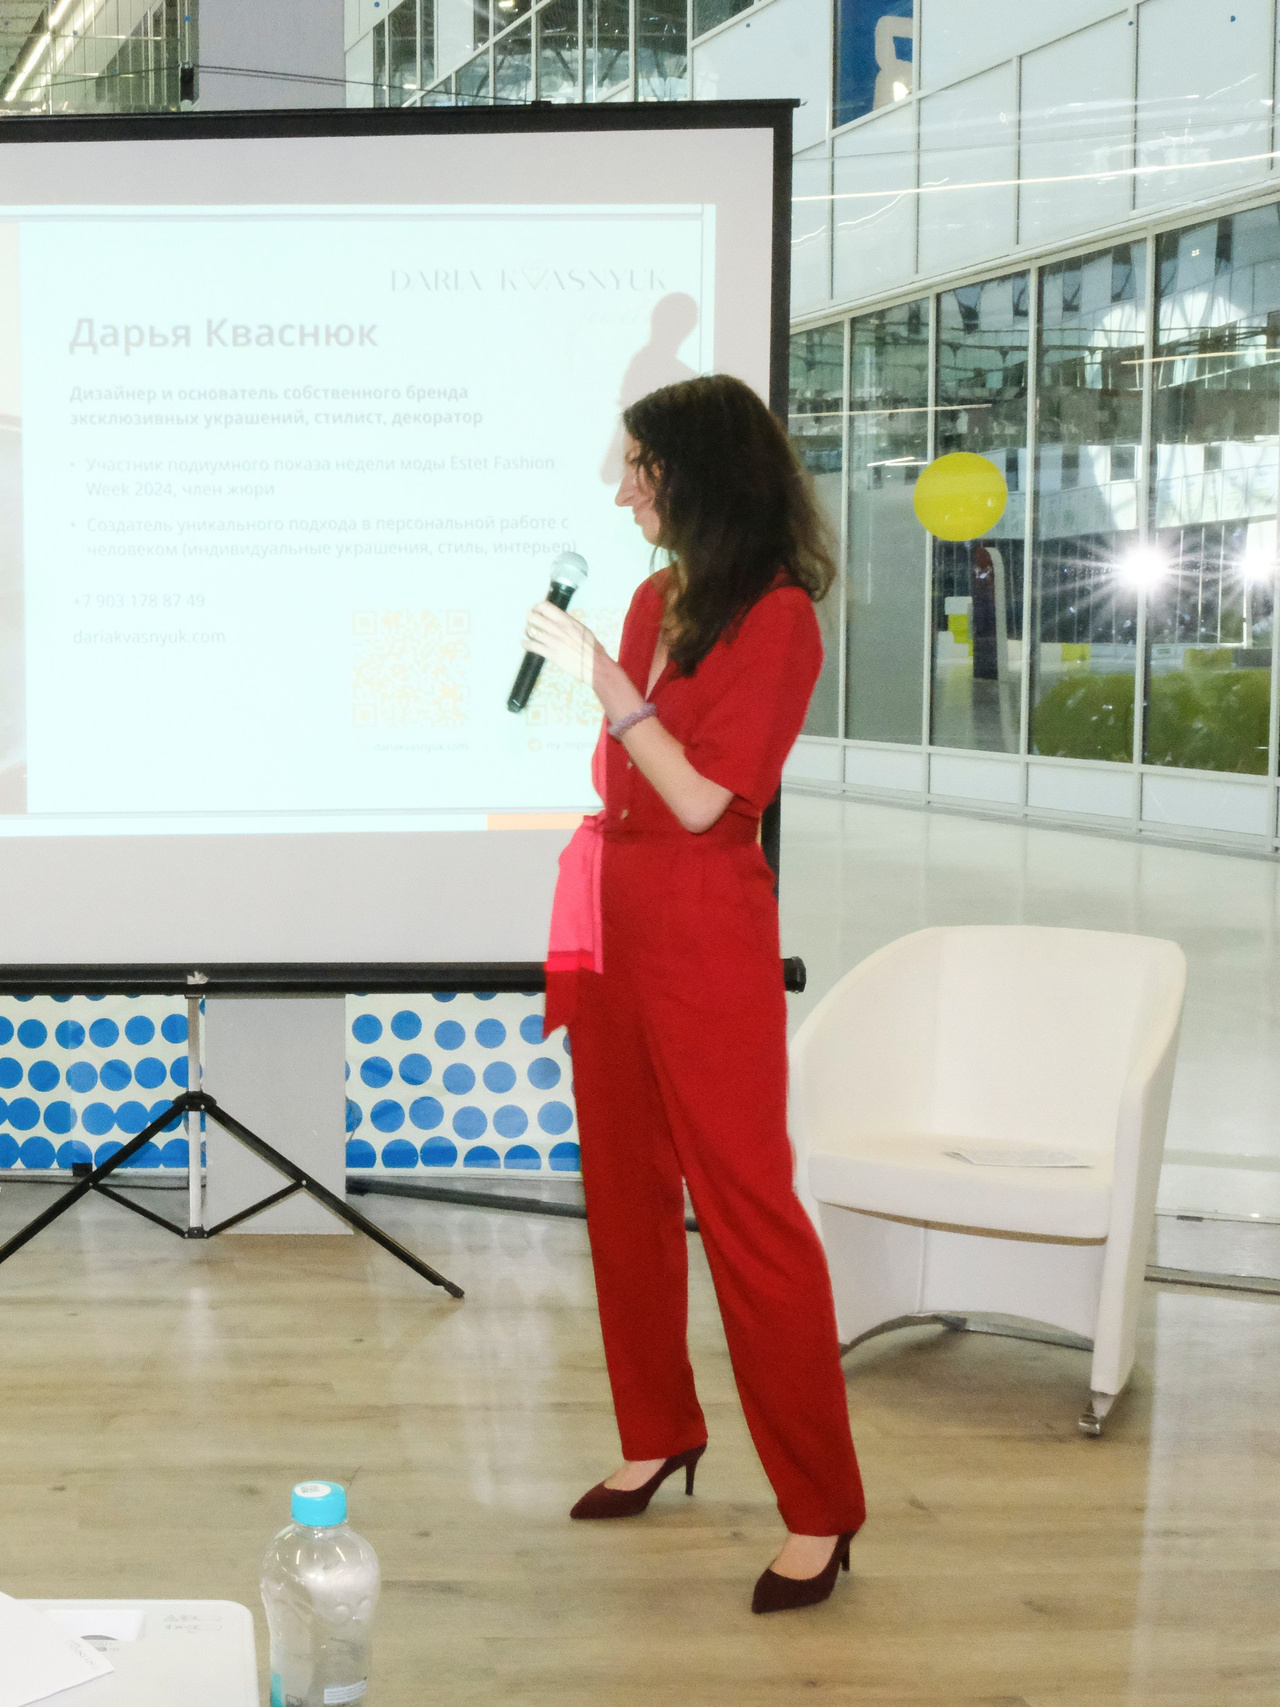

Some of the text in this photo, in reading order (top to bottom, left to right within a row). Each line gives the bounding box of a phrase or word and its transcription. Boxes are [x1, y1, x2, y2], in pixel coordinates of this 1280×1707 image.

[390, 267, 666, 293] DARIA KVASNYUK
[67, 316, 380, 357] Дарья Кваснюк
[68, 383, 470, 405] Дизайнер и основатель собственного бренда
[69, 409, 485, 430] эксклюзивных украшений, стилист, декоратор
[85, 454, 557, 476] Участник подиумного показа недели моды Estet Fashion
[85, 481, 276, 500] Week 2024, член жюри
[86, 514, 570, 536] Создатель уникального подхода в персональной работе с
[86, 540, 577, 560] человеком (индивидуальные украшения, стиль, интерьер)
[73, 592, 207, 609] +7 903 178 87 49
[72, 628, 227, 648] dariakvasnyuk.com
